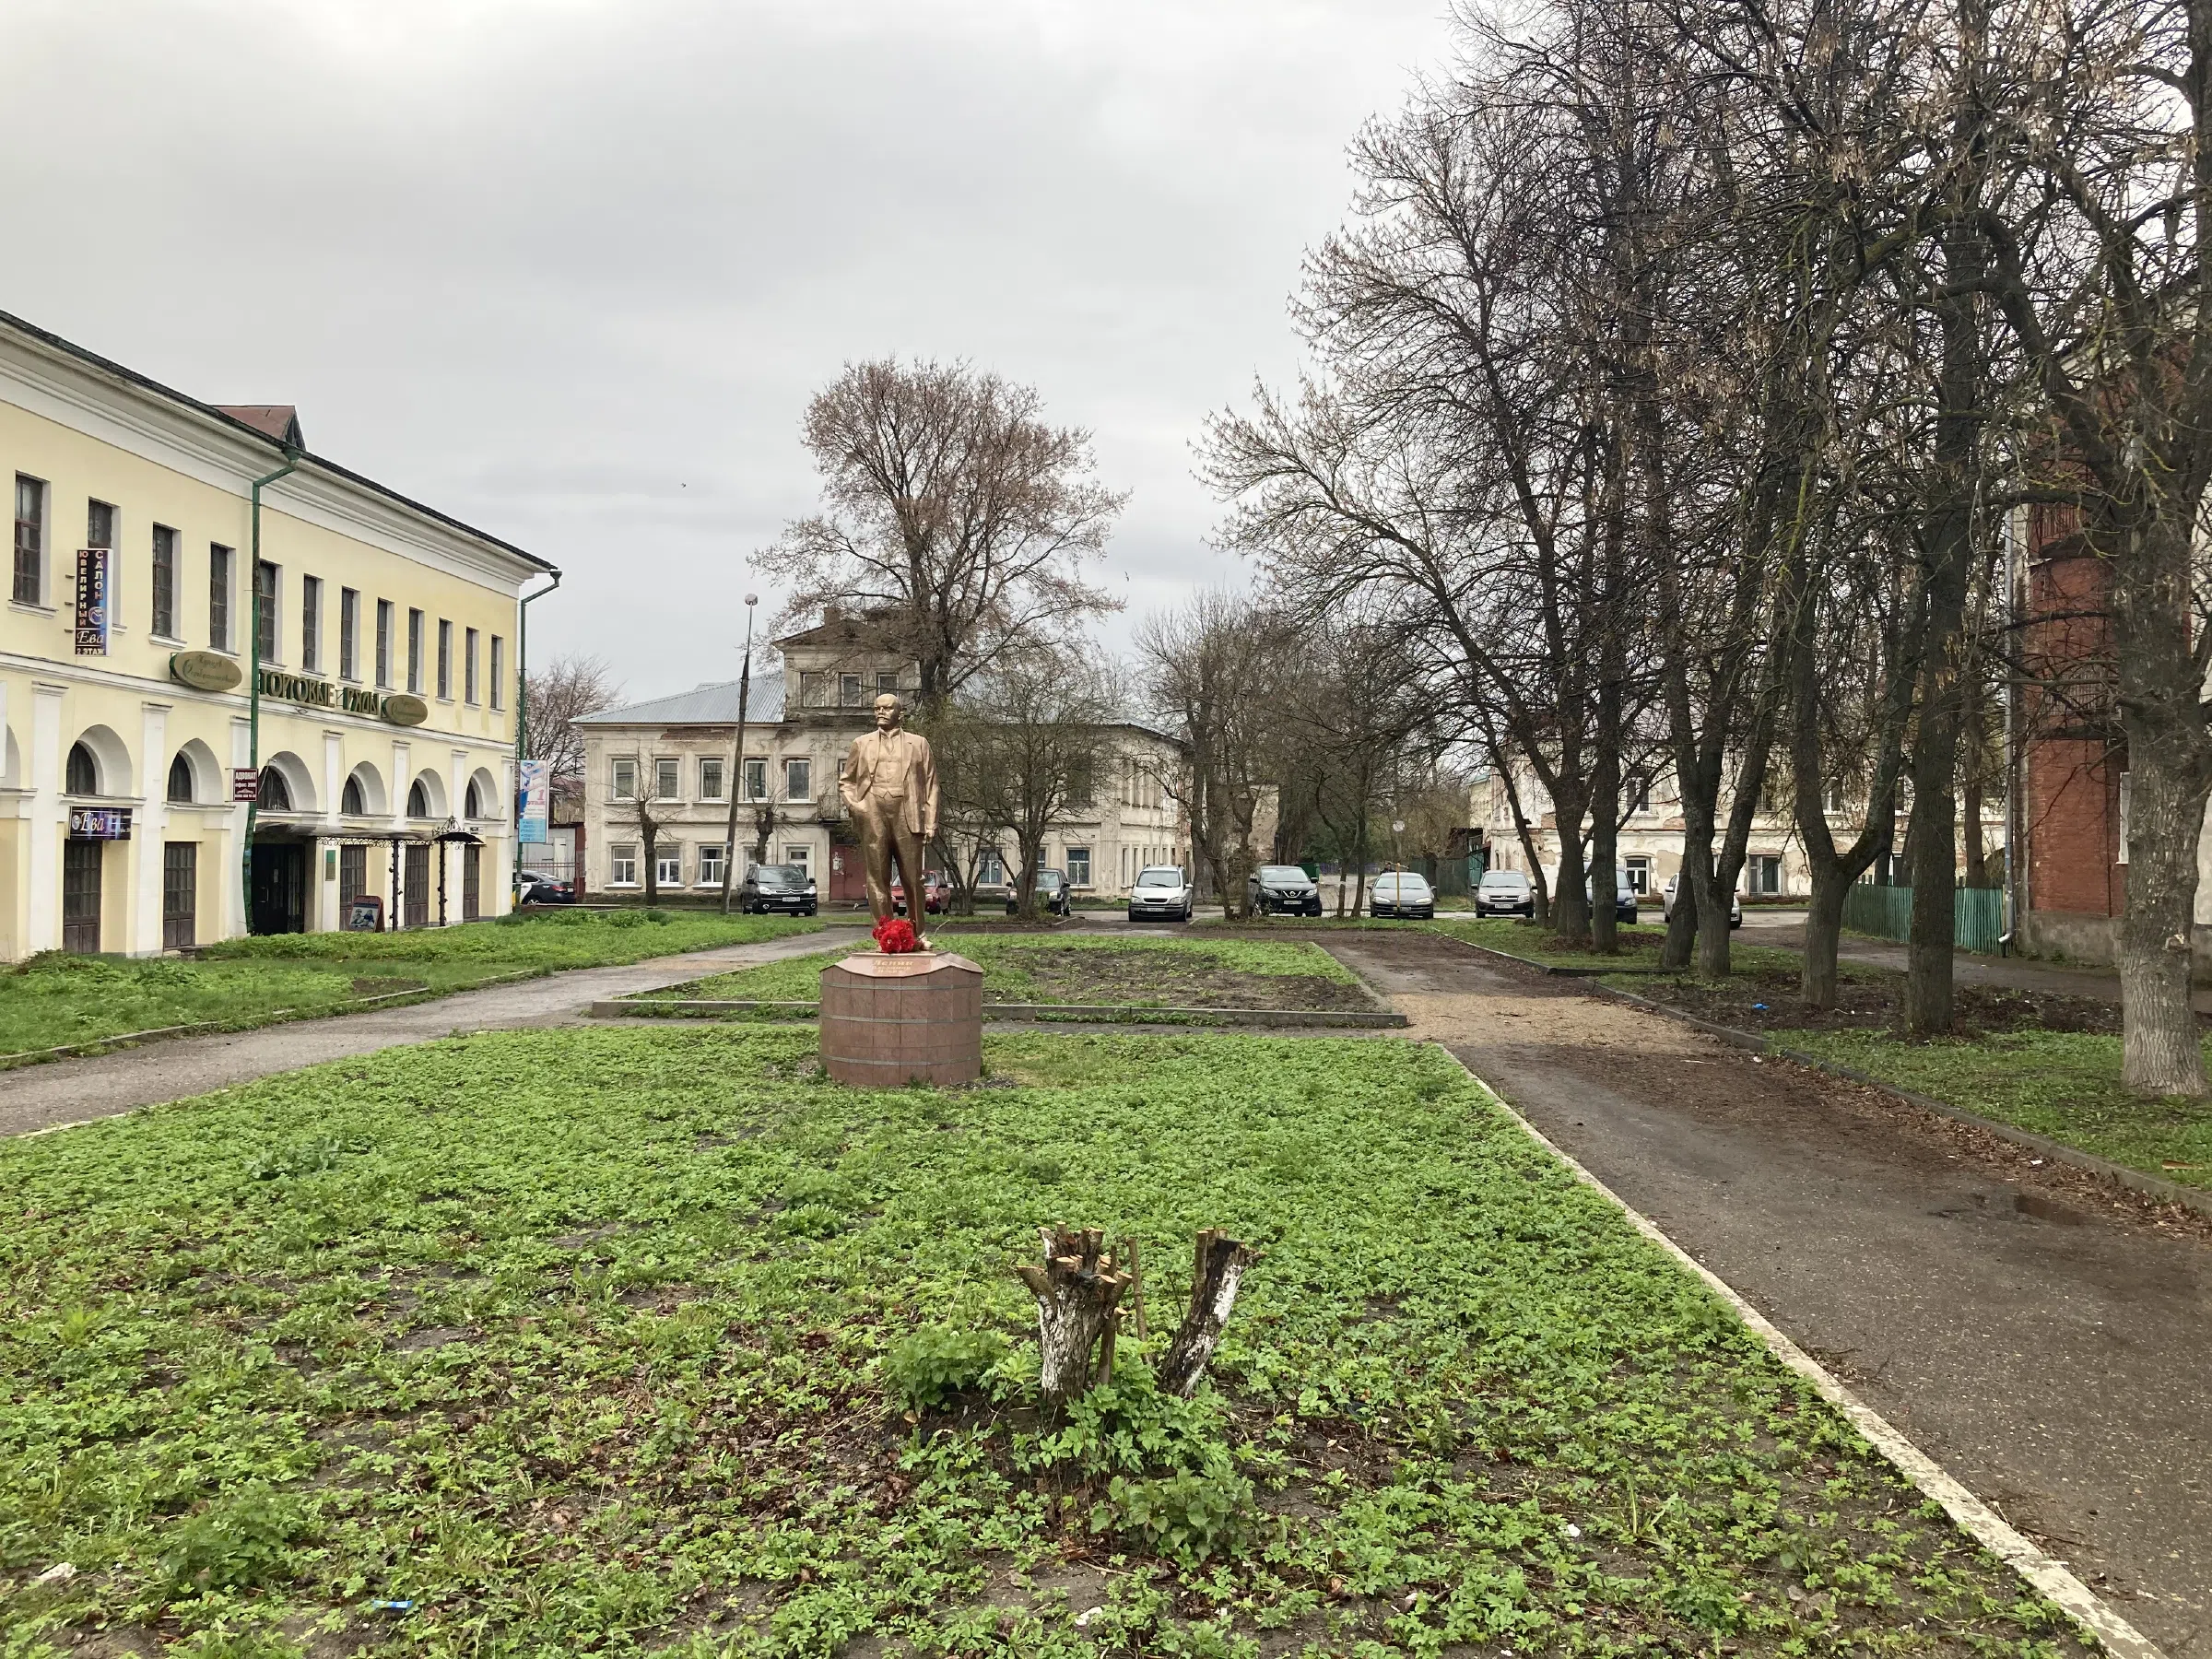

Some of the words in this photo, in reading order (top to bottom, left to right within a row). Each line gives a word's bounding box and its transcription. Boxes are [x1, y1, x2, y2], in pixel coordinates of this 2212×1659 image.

[78, 551, 88, 626] ЮВЕЛИРНЫЙ
[95, 551, 104, 600] САЛОН
[76, 630, 104, 644] Ева
[260, 669, 335, 708] ТОРГОВЫЕ
[343, 687, 379, 715] РЯДЫ
[235, 771, 256, 782] АДВОКАТ
[80, 812, 105, 831] Ева
